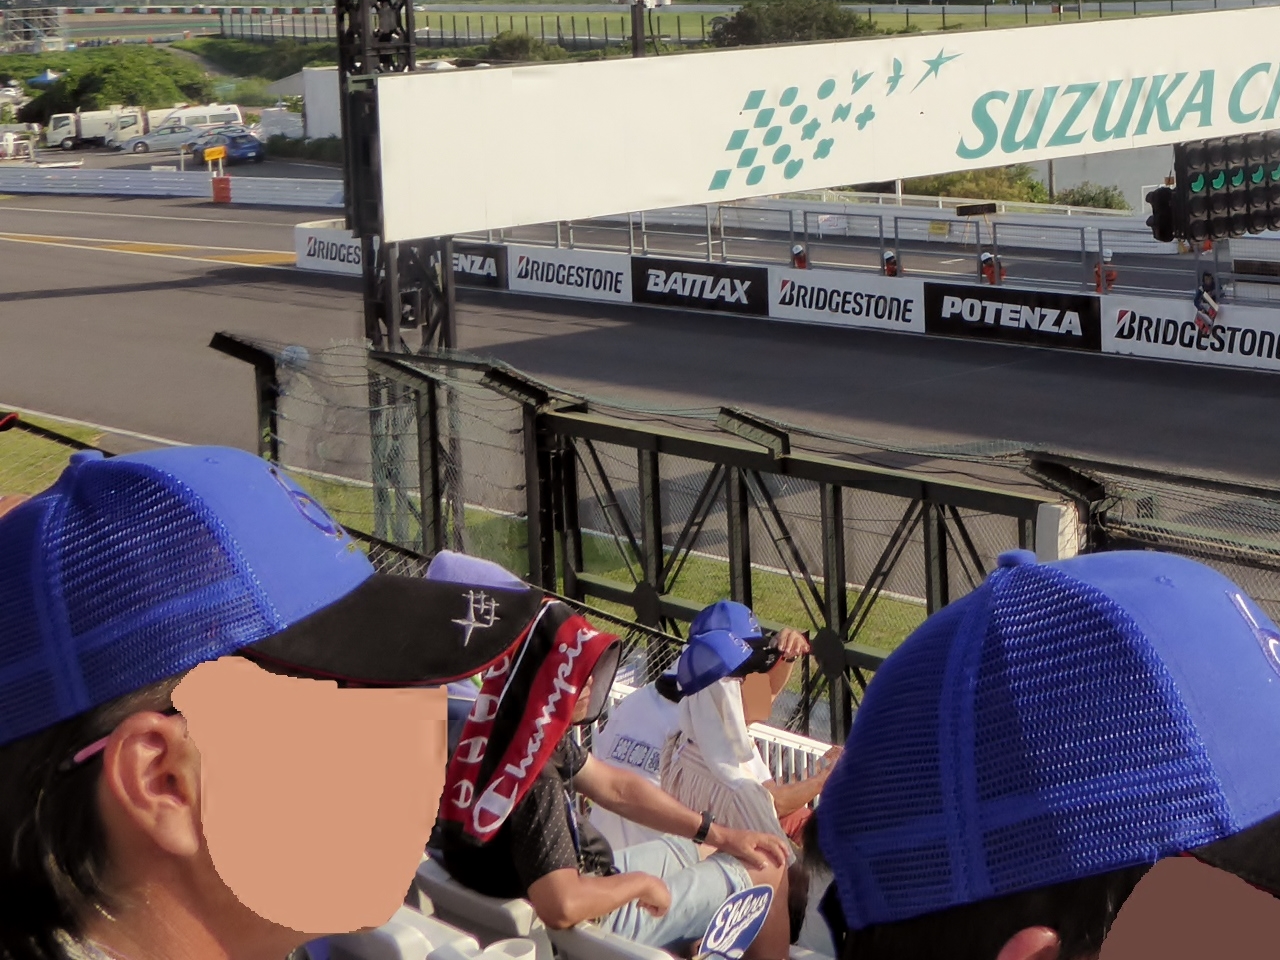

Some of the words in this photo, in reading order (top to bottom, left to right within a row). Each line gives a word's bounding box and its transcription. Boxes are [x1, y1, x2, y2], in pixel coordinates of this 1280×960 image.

[955, 69, 1216, 160] SUZUKA
[306, 236, 362, 265] BRIDGES
[452, 252, 498, 277] ENZA
[516, 256, 624, 294] BRIDGESTONE
[646, 268, 752, 305] BATTLAX
[778, 279, 914, 324] BRIDGESTONE
[941, 295, 1083, 336] POTENZA
